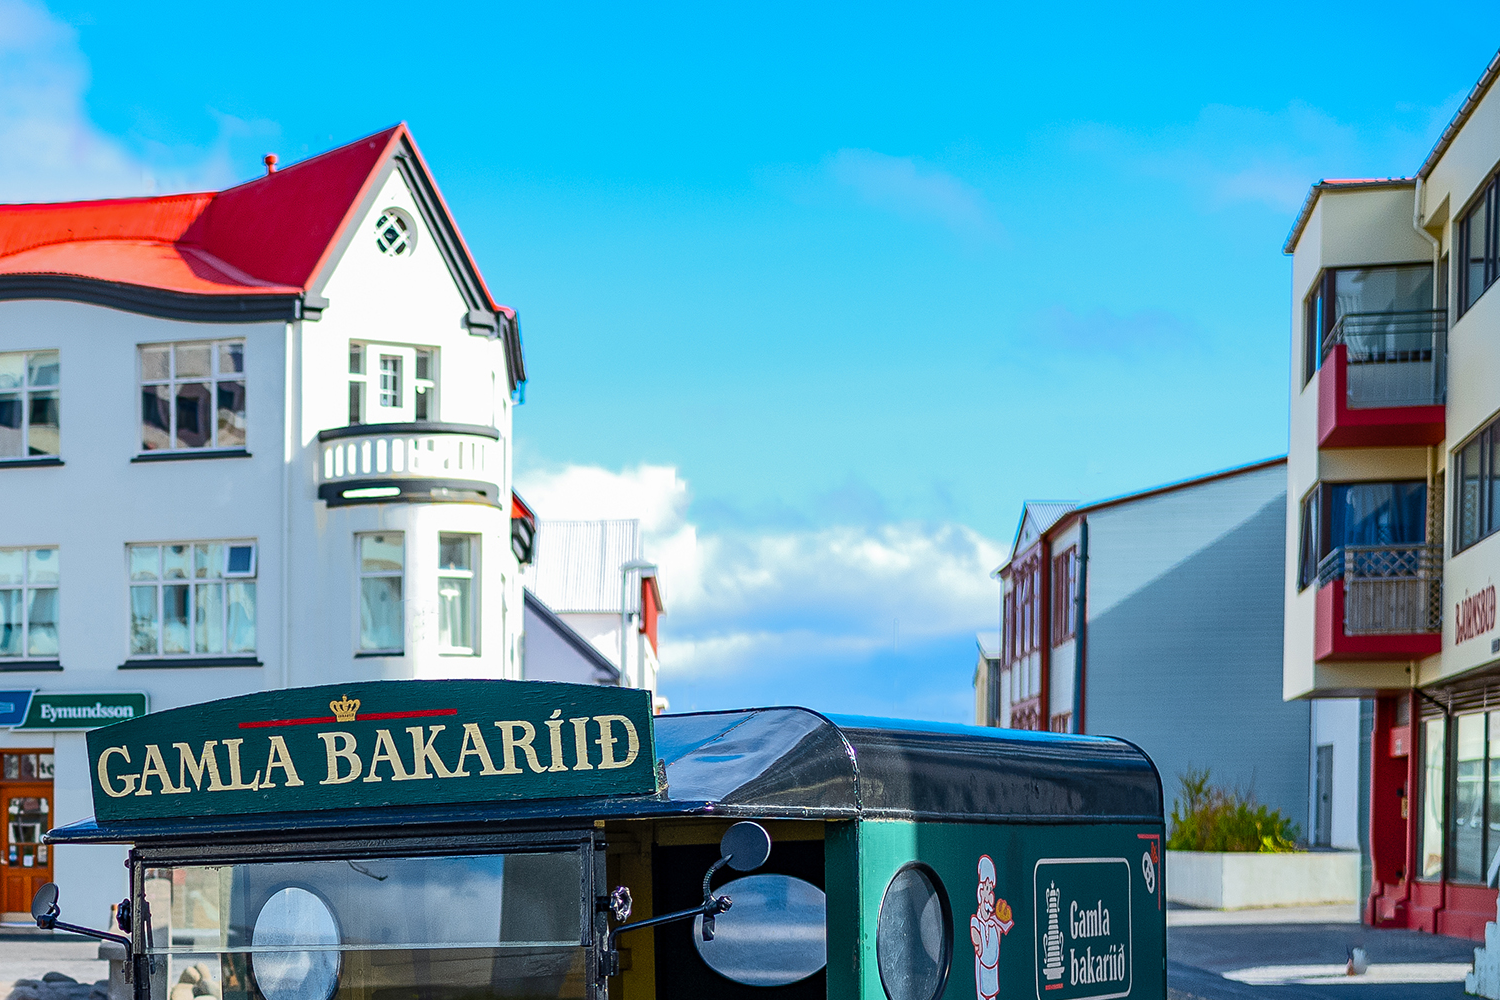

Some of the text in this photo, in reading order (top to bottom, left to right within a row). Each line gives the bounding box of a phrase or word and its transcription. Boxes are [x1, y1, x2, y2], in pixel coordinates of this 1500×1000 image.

[41, 702, 134, 722] Eymundsson
[98, 709, 641, 798] GAMLA BAKARÍIÐ
[1070, 900, 1111, 940] Gamla
[1070, 943, 1125, 986] bakaríið
